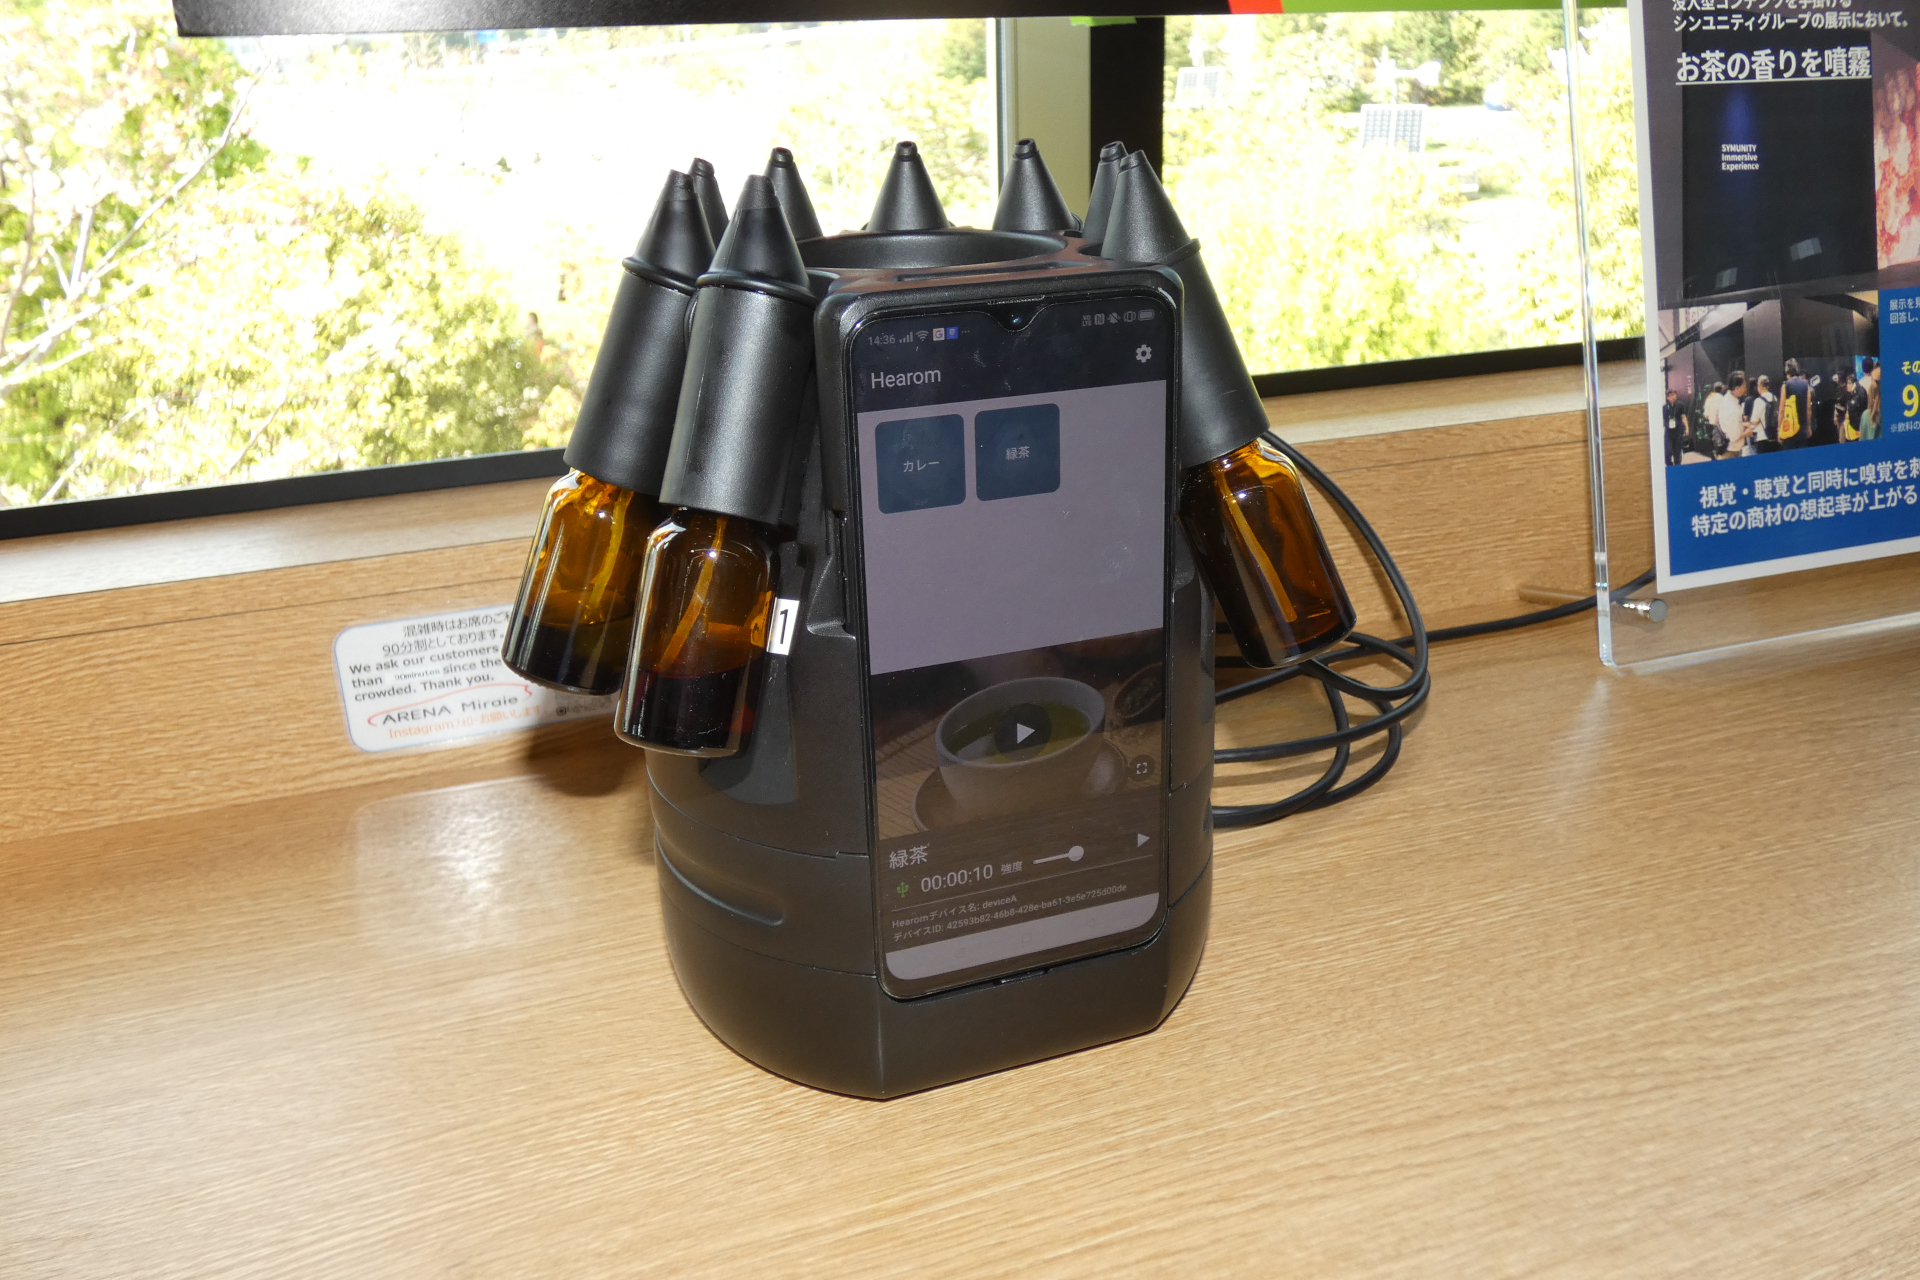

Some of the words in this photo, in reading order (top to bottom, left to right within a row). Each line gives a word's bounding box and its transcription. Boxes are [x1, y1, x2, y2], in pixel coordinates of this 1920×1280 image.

[1673, 10, 1908, 32] シンユニティグループの展示において。
[1676, 46, 1872, 82] お茶の香りを噴霧
[1721, 143, 1757, 153] SYMUNITY
[1721, 153, 1758, 162] Immersive
[1721, 162, 1760, 172] Experience
[868, 334, 896, 346] 14:36
[870, 367, 942, 389] Hearom
[1005, 446, 1031, 461] 緑茶
[903, 459, 940, 473] カレー
[1691, 484, 1918, 538] 特定の商材の想起率が上がる
[779, 608, 789, 645] 1
[349, 664, 371, 675] We
[375, 658, 399, 671] ask
[403, 656, 424, 667] our
[430, 644, 499, 663] customers
[351, 676, 383, 688] than
[442, 663, 477, 675] since
[481, 657, 502, 668] the
[354, 684, 417, 702] crowded.
[420, 677, 462, 692] Thank
[466, 674, 494, 687] you.
[382, 705, 452, 725] ARENA
[461, 697, 518, 712] Miraie
[889, 845, 928, 870] 緑茶
[1000, 861, 1023, 876] 強度
[921, 864, 994, 893] 00:00:10
[982, 894, 1017, 910] deviceA
